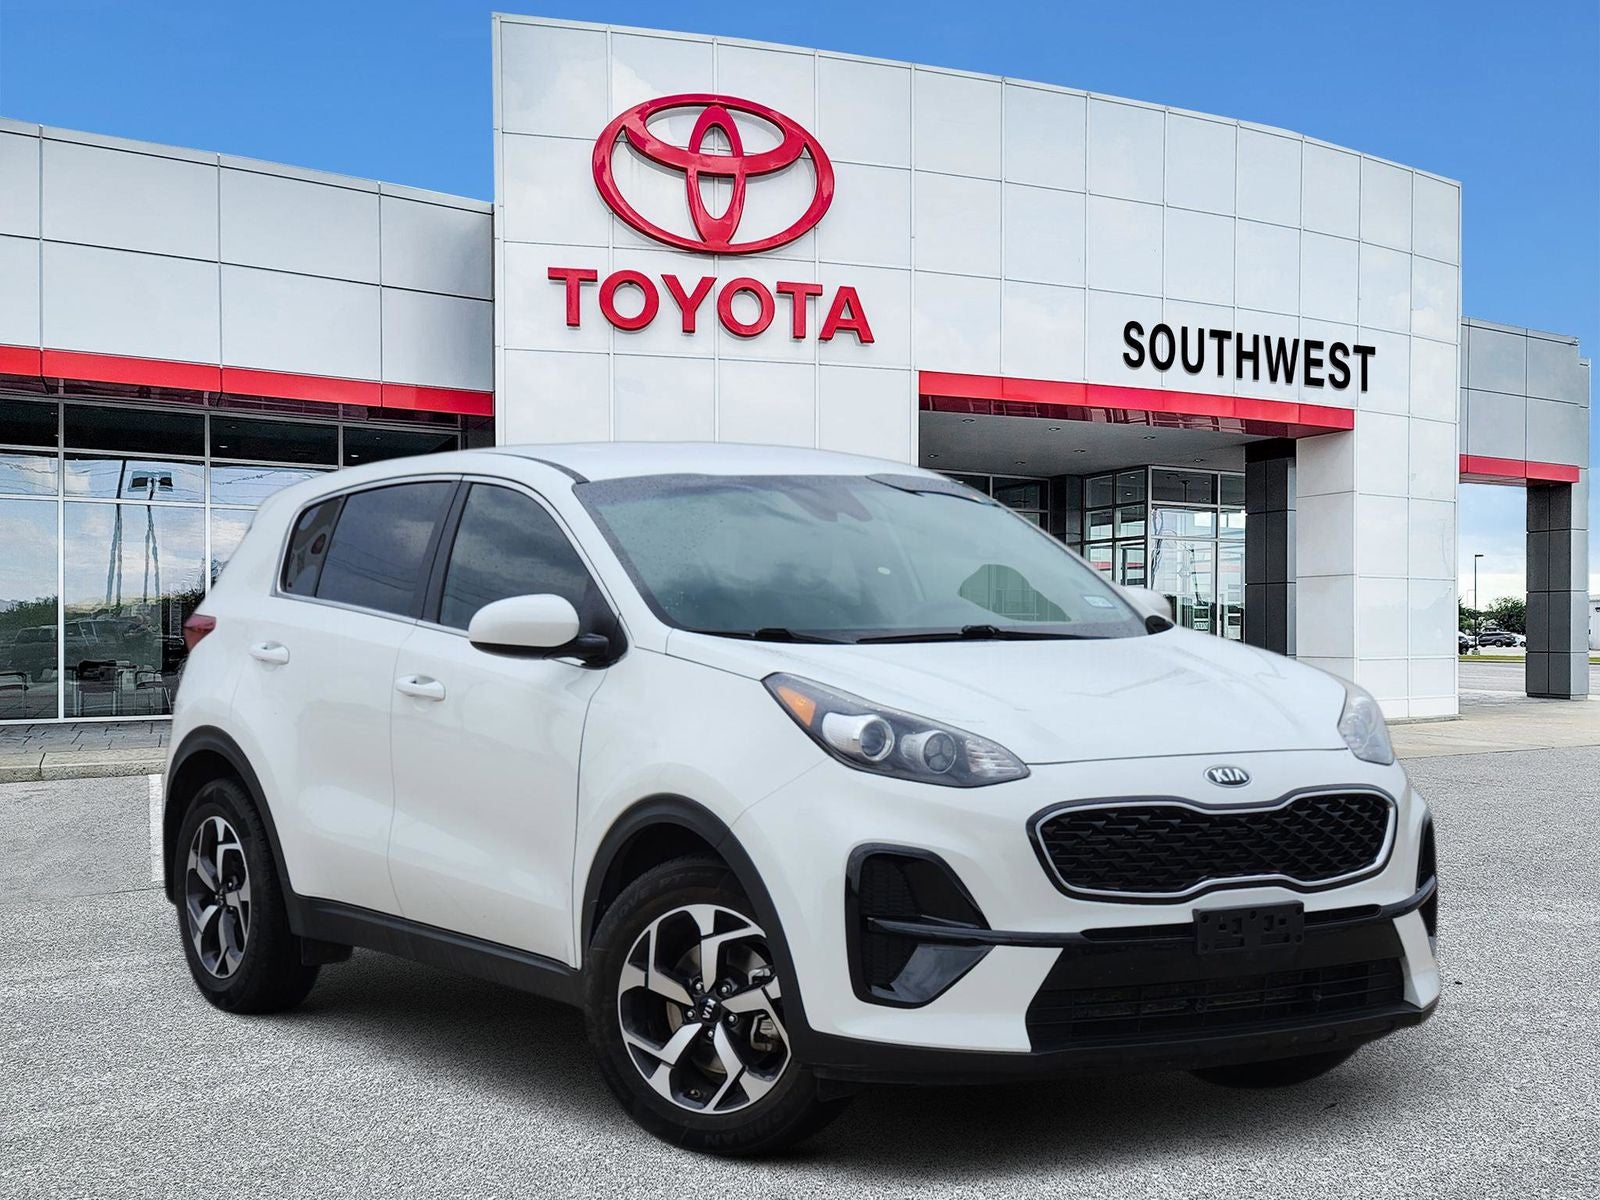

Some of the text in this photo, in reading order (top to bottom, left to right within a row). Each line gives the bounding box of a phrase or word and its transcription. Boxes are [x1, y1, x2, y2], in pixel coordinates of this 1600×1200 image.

[548, 267, 875, 343] TOYOTA
[1123, 321, 1376, 392] SOUTHWEST
[1209, 767, 1249, 783] KIA
